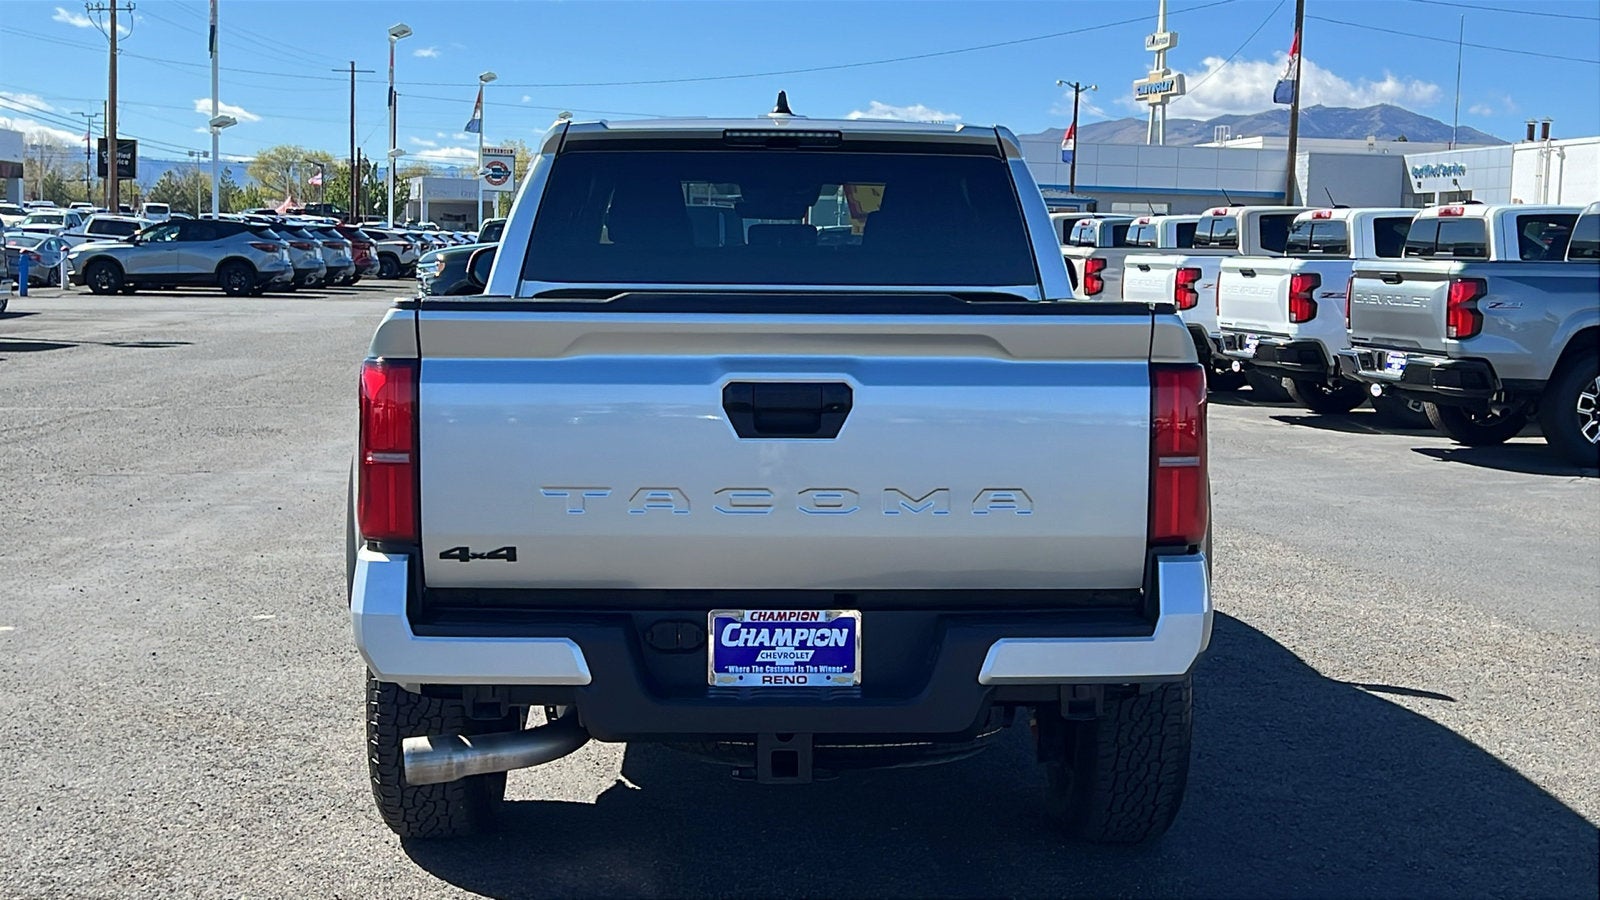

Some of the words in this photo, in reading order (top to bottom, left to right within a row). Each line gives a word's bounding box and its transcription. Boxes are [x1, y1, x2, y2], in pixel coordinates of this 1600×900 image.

[1353, 293, 1431, 308] CHEVROLET
[539, 486, 1034, 515] TACOMA
[439, 546, 517, 562] 4x4
[750, 611, 819, 622] CHAMPION
[721, 622, 848, 647] CHAMPION
[760, 651, 810, 660] CHEVROLET
[752, 665, 761, 673] The
[765, 665, 796, 673] Customer
[798, 665, 804, 673] Is
[806, 665, 817, 673] The
[762, 675, 808, 685] RENO
